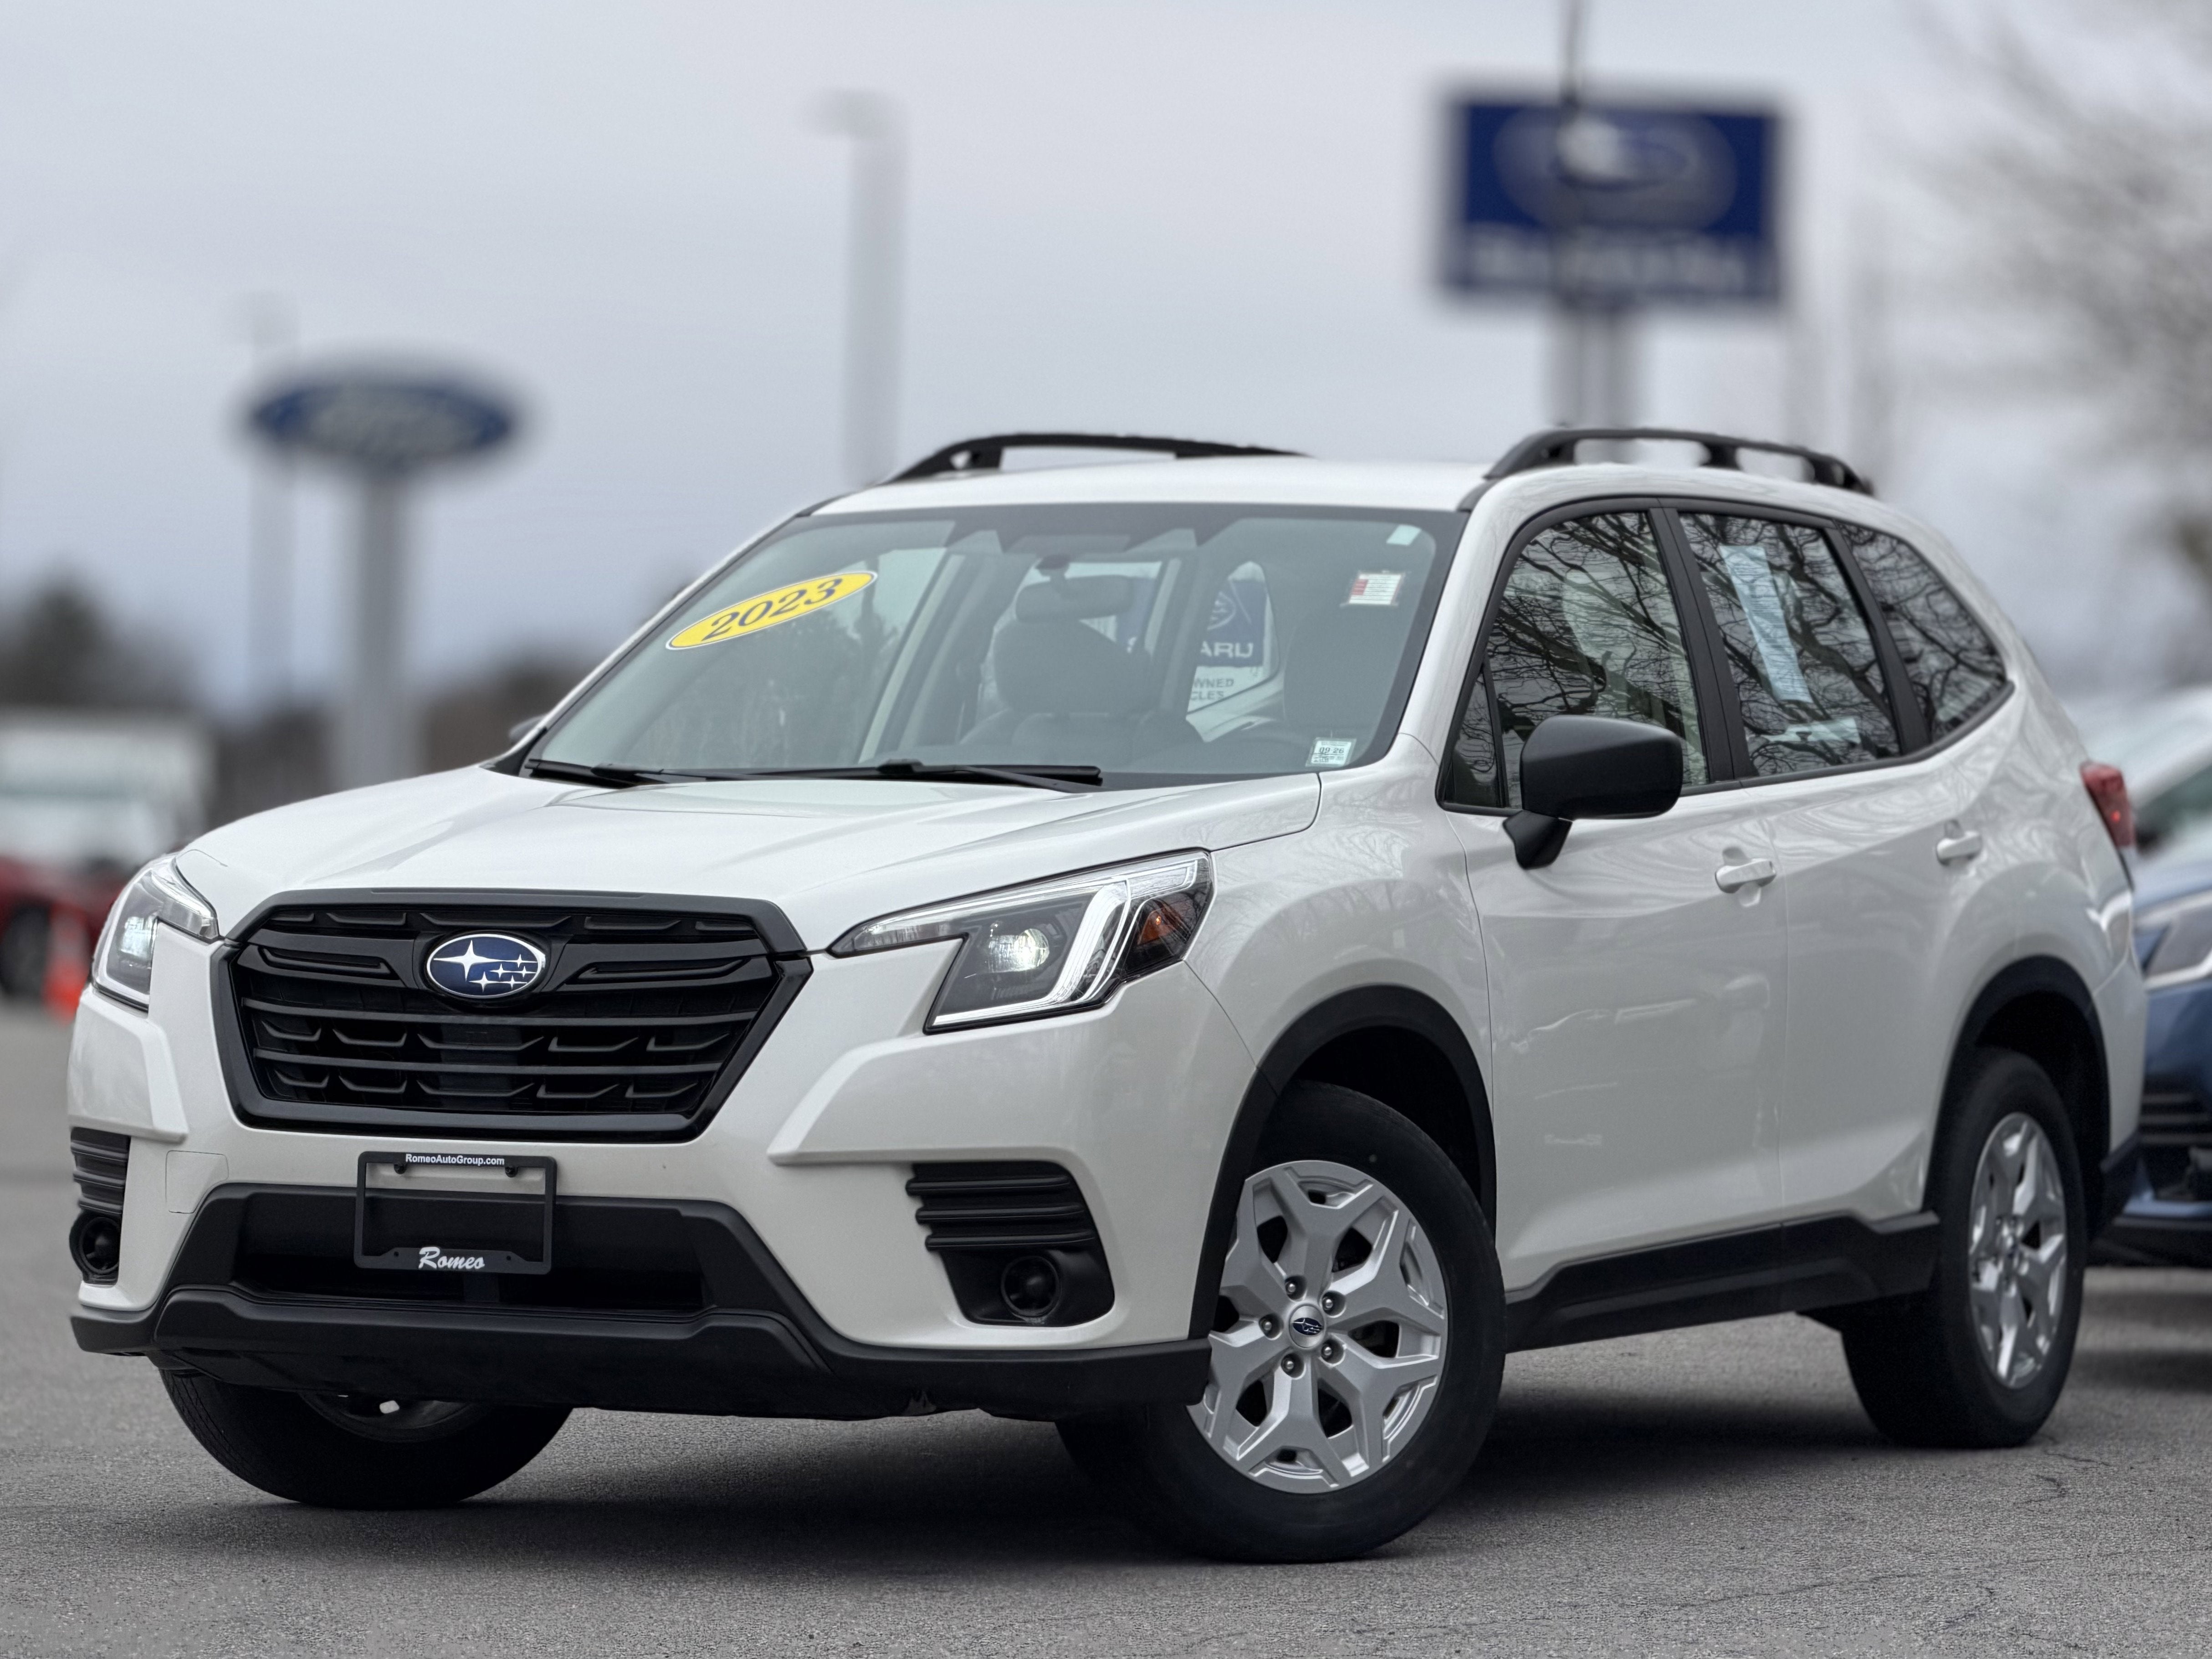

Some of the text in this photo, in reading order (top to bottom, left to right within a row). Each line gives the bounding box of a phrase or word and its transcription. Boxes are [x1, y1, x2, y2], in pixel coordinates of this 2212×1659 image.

[701, 578, 843, 641] 2023
[405, 1153, 505, 1166] RomeoAutoGroup.com
[418, 1246, 485, 1270] Romeo
